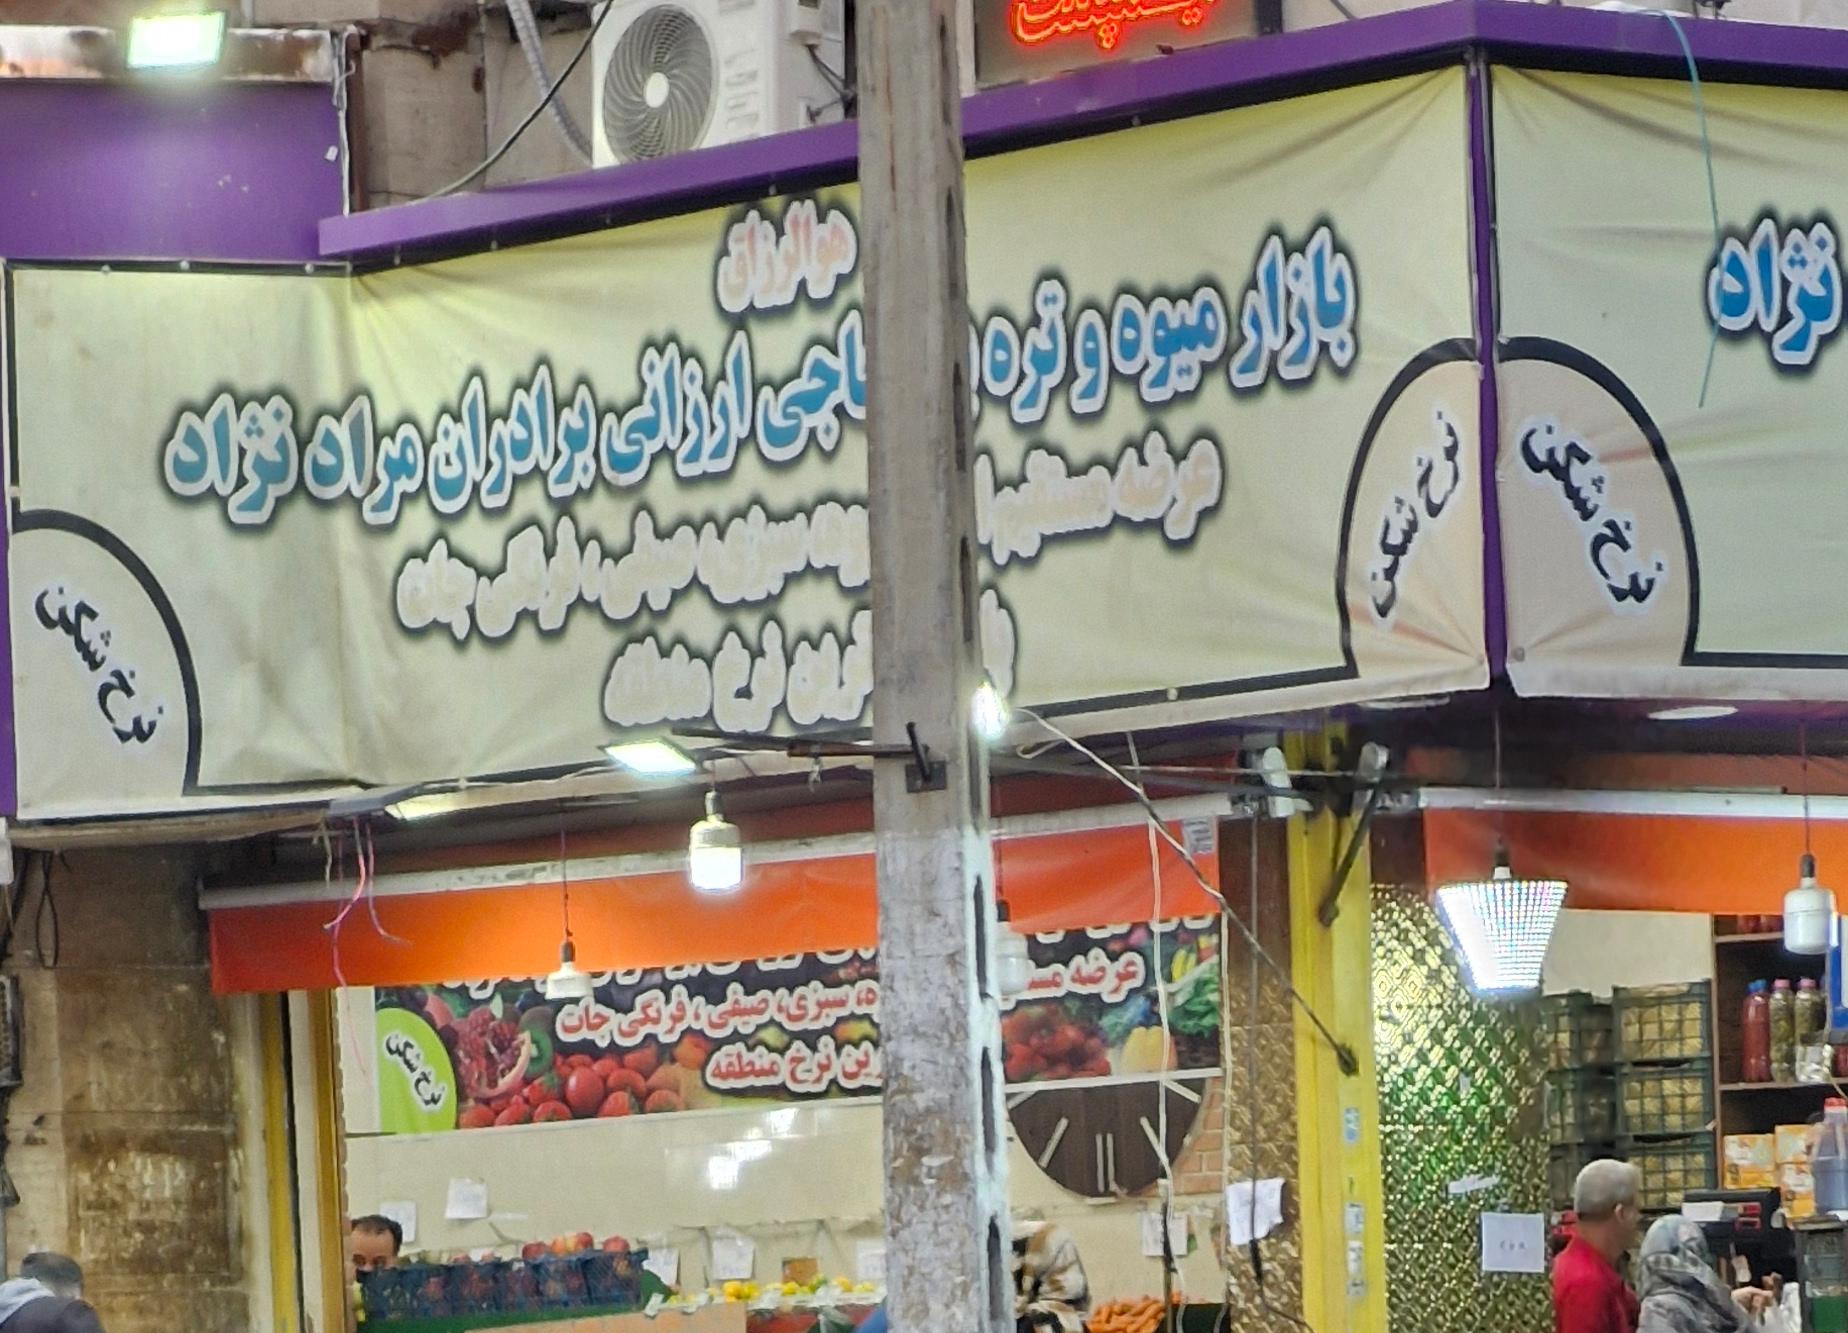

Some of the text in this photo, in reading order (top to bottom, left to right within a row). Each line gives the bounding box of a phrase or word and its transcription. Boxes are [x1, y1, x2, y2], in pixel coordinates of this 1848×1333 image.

[982, 279, 1067, 423] تره
[1111, 286, 1228, 402] میوه
[1229, 227, 1354, 387] بازار
[1708, 218, 1842, 364] نژاد
[601, 331, 751, 486] ارزانی
[756, 309, 866, 461] اجی
[1070, 309, 1108, 413] و
[165, 393, 298, 524] نژاد
[304, 395, 424, 525] مراد
[428, 365, 596, 513] برادران
[1371, 411, 1459, 618] نرخ شکن
[1522, 424, 1664, 603] نرخ شکن
[35, 586, 164, 744] نرخ شکن
[386, 1034, 446, 1106] نرخ شکن
[558, 998, 614, 1045] جات
[615, 985, 688, 1044] فرنگی
[707, 1043, 783, 1087] منطقه
[785, 1036, 836, 1090] نرخ
